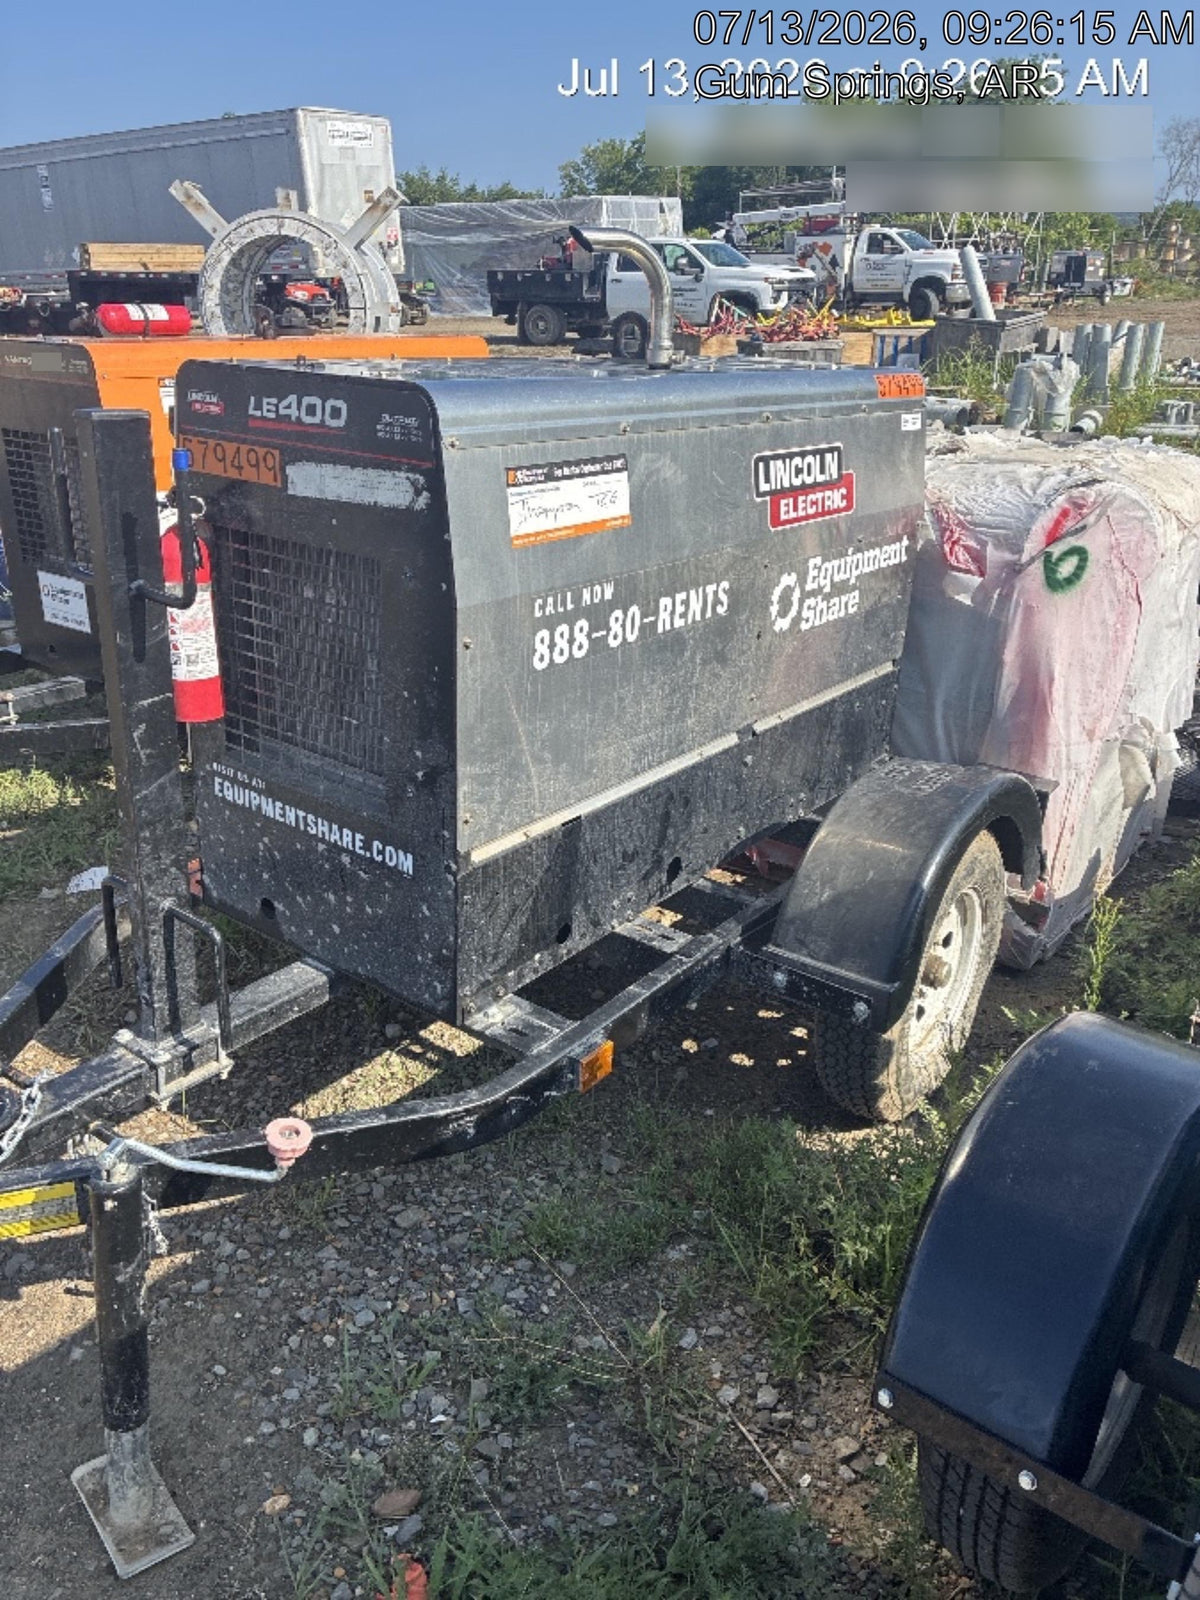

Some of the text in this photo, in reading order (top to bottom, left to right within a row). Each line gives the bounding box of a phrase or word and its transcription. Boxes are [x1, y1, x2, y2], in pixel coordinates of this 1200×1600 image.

[248, 394, 348, 428] LE400
[758, 451, 839, 493] LINCOLN
[780, 487, 848, 521] ELECTRIC
[804, 535, 910, 593] Equipment
[534, 580, 615, 618] CALL NOW
[800, 589, 860, 632] Share
[532, 581, 731, 671] 888-80-RENTS
[214, 776, 414, 876] EQUIPMENTSHARE.COM
